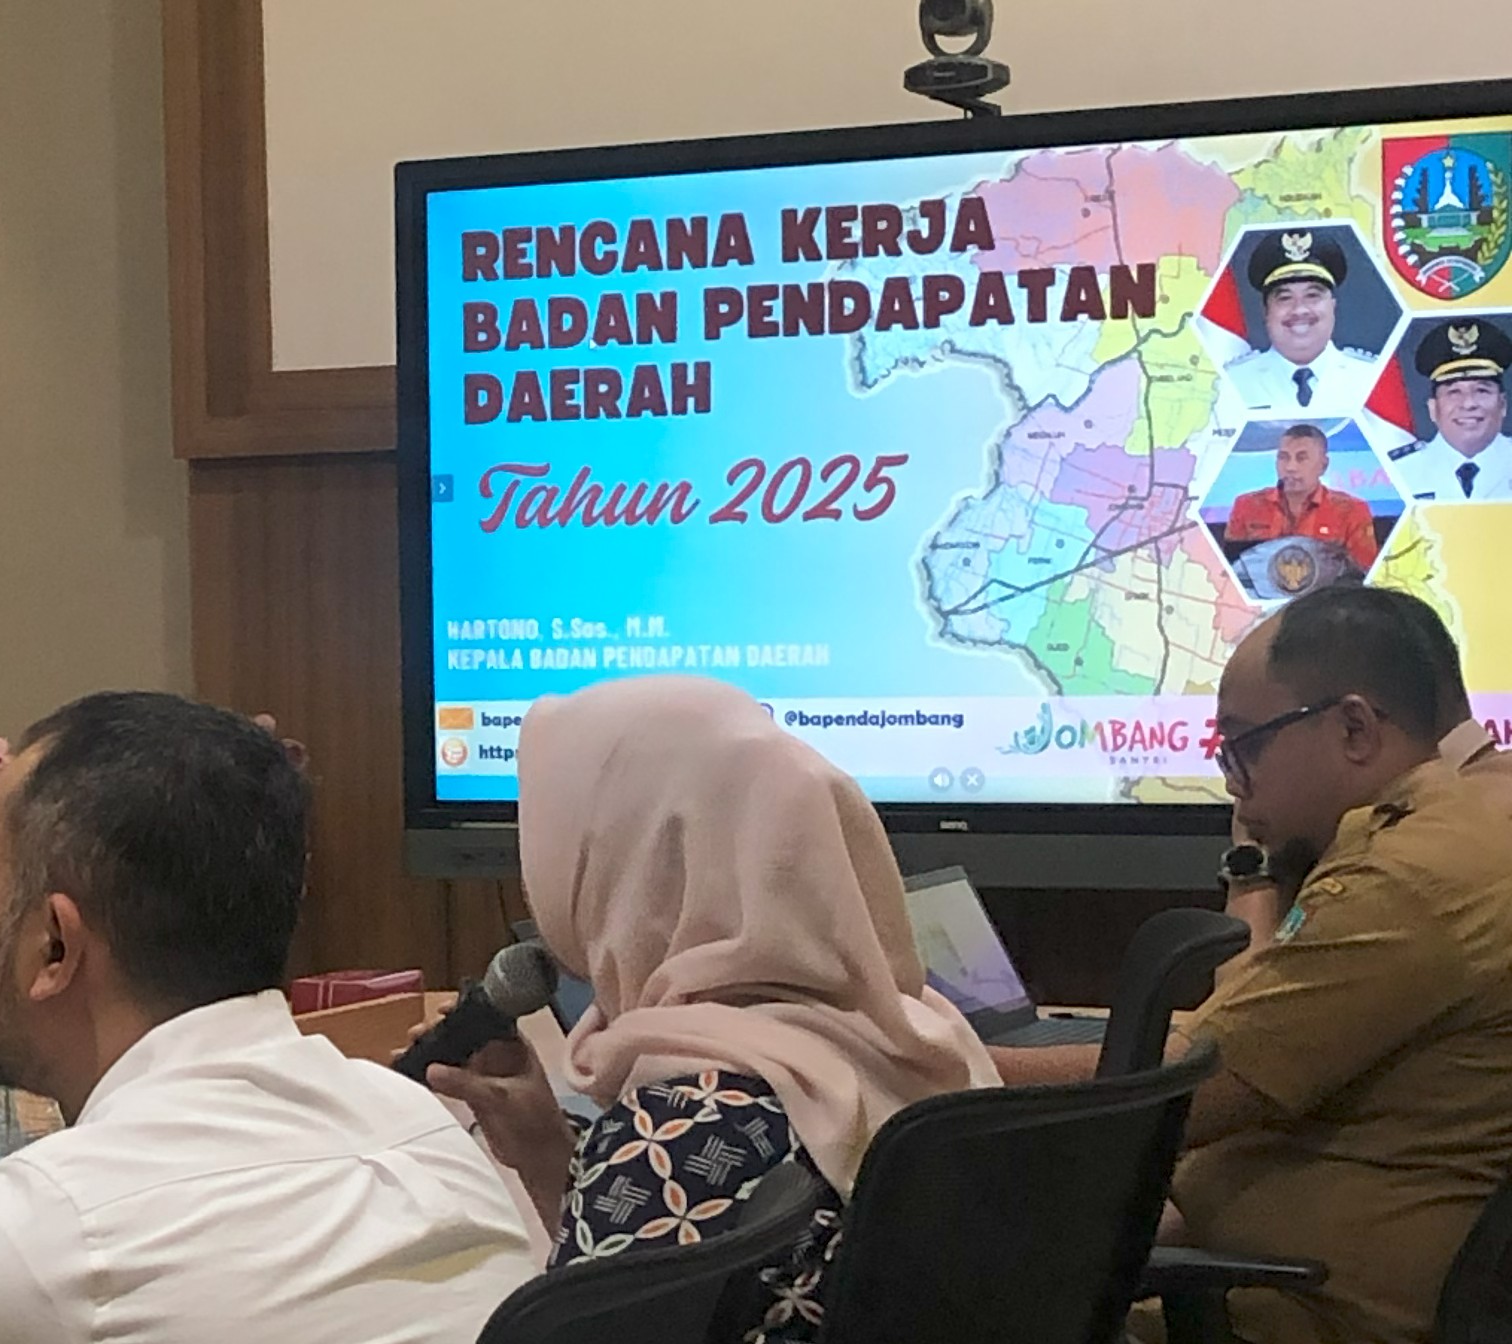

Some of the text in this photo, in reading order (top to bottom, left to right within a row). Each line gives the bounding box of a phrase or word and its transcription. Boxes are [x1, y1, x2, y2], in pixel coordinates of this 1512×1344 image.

[461, 196, 995, 282] RENCANA KERJA
[462, 263, 1156, 353] BADAN PENDAPATAN
[464, 361, 712, 425] DAERAH
[479, 453, 909, 533] Tahun 2025
[447, 648, 524, 670] KEPALA
[602, 645, 740, 669] PENDAPATAN
[746, 644, 830, 667] DAERAH
[784, 710, 965, 729] @bapendajombang
[1014, 702, 1189, 755] JOMBANG
[479, 745, 519, 761] http
